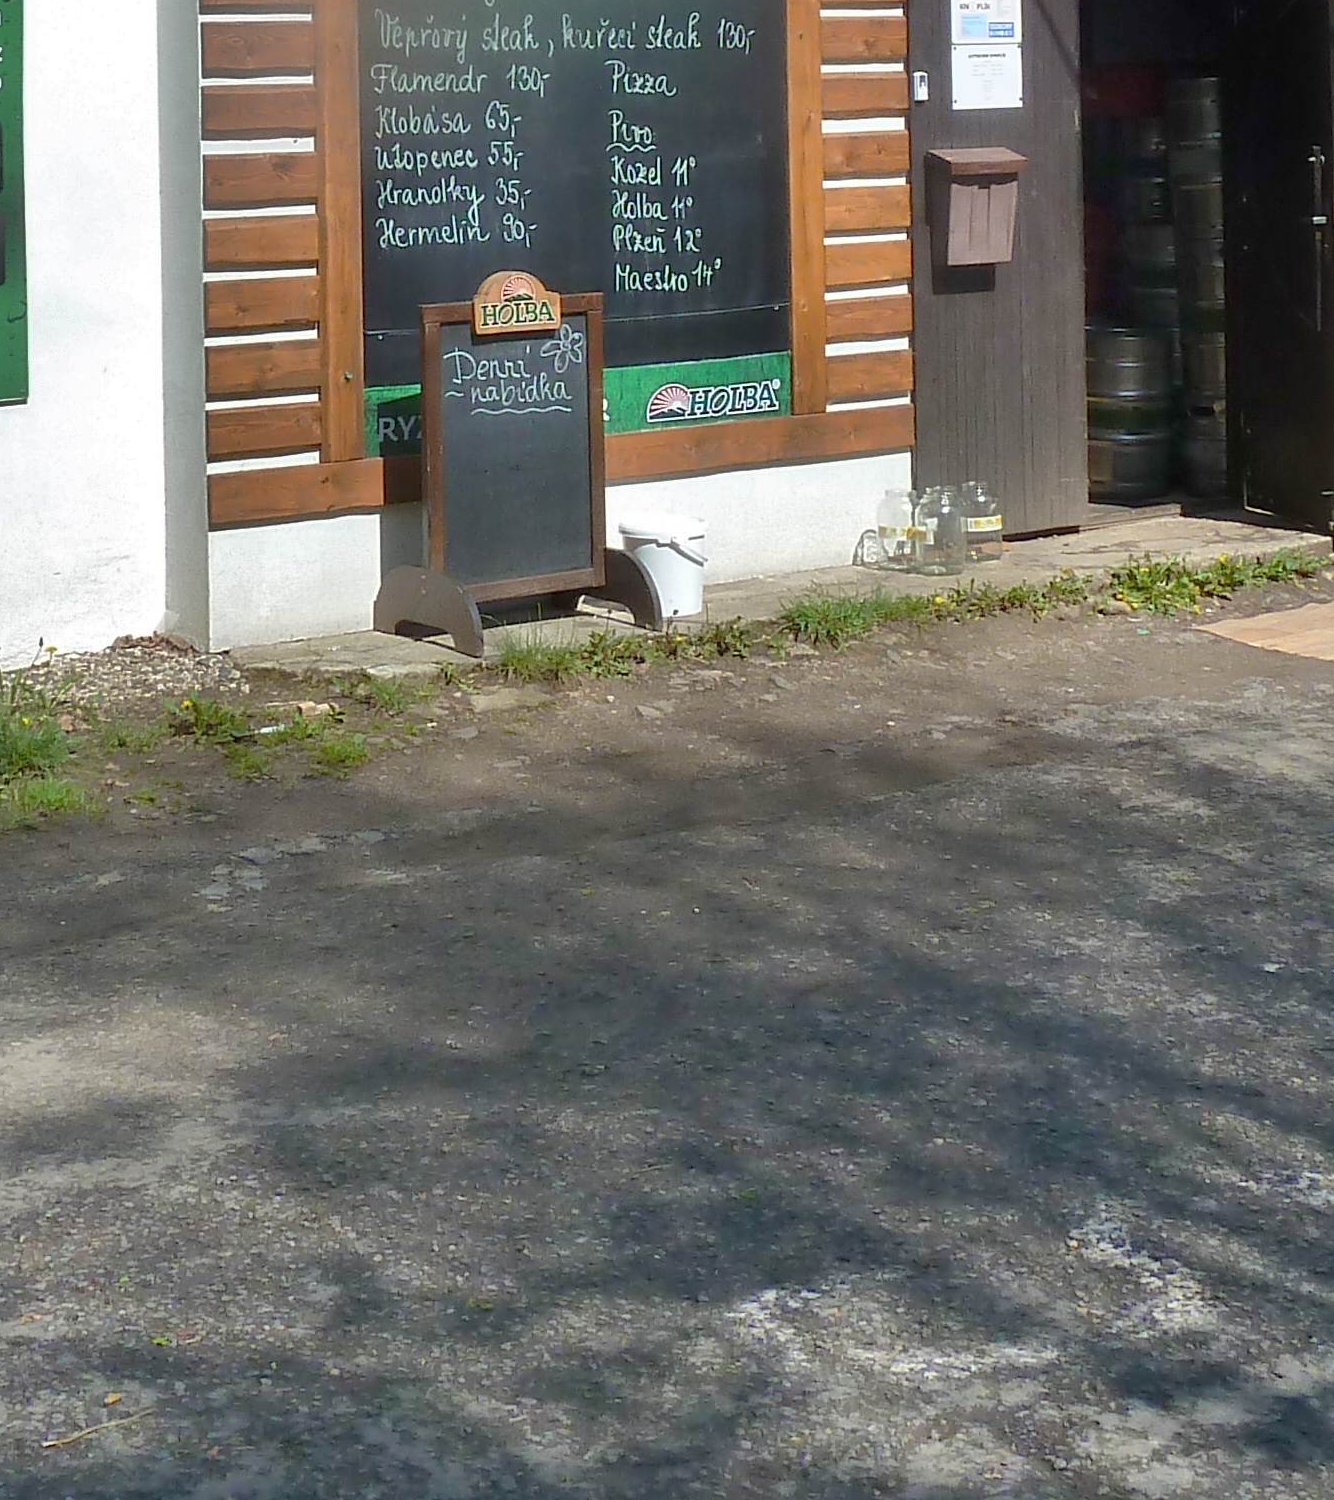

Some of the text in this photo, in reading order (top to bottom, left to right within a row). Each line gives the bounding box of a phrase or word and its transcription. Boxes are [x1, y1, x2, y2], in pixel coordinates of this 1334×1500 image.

[645, 11, 702, 49] steak
[370, 64, 488, 95] Flamendr
[603, 59, 677, 97] Pizza
[375, 104, 472, 140] Klobása
[610, 155, 662, 186] Kozel
[376, 175, 485, 226] Hranolky
[612, 189, 668, 221] Holba
[615, 263, 689, 293] Maestro
[481, 300, 556, 328] HOLBA
[442, 346, 532, 385] Denní
[470, 371, 573, 406] nabídka
[686, 380, 779, 420] HOLBA
[377, 415, 421, 443] RY
